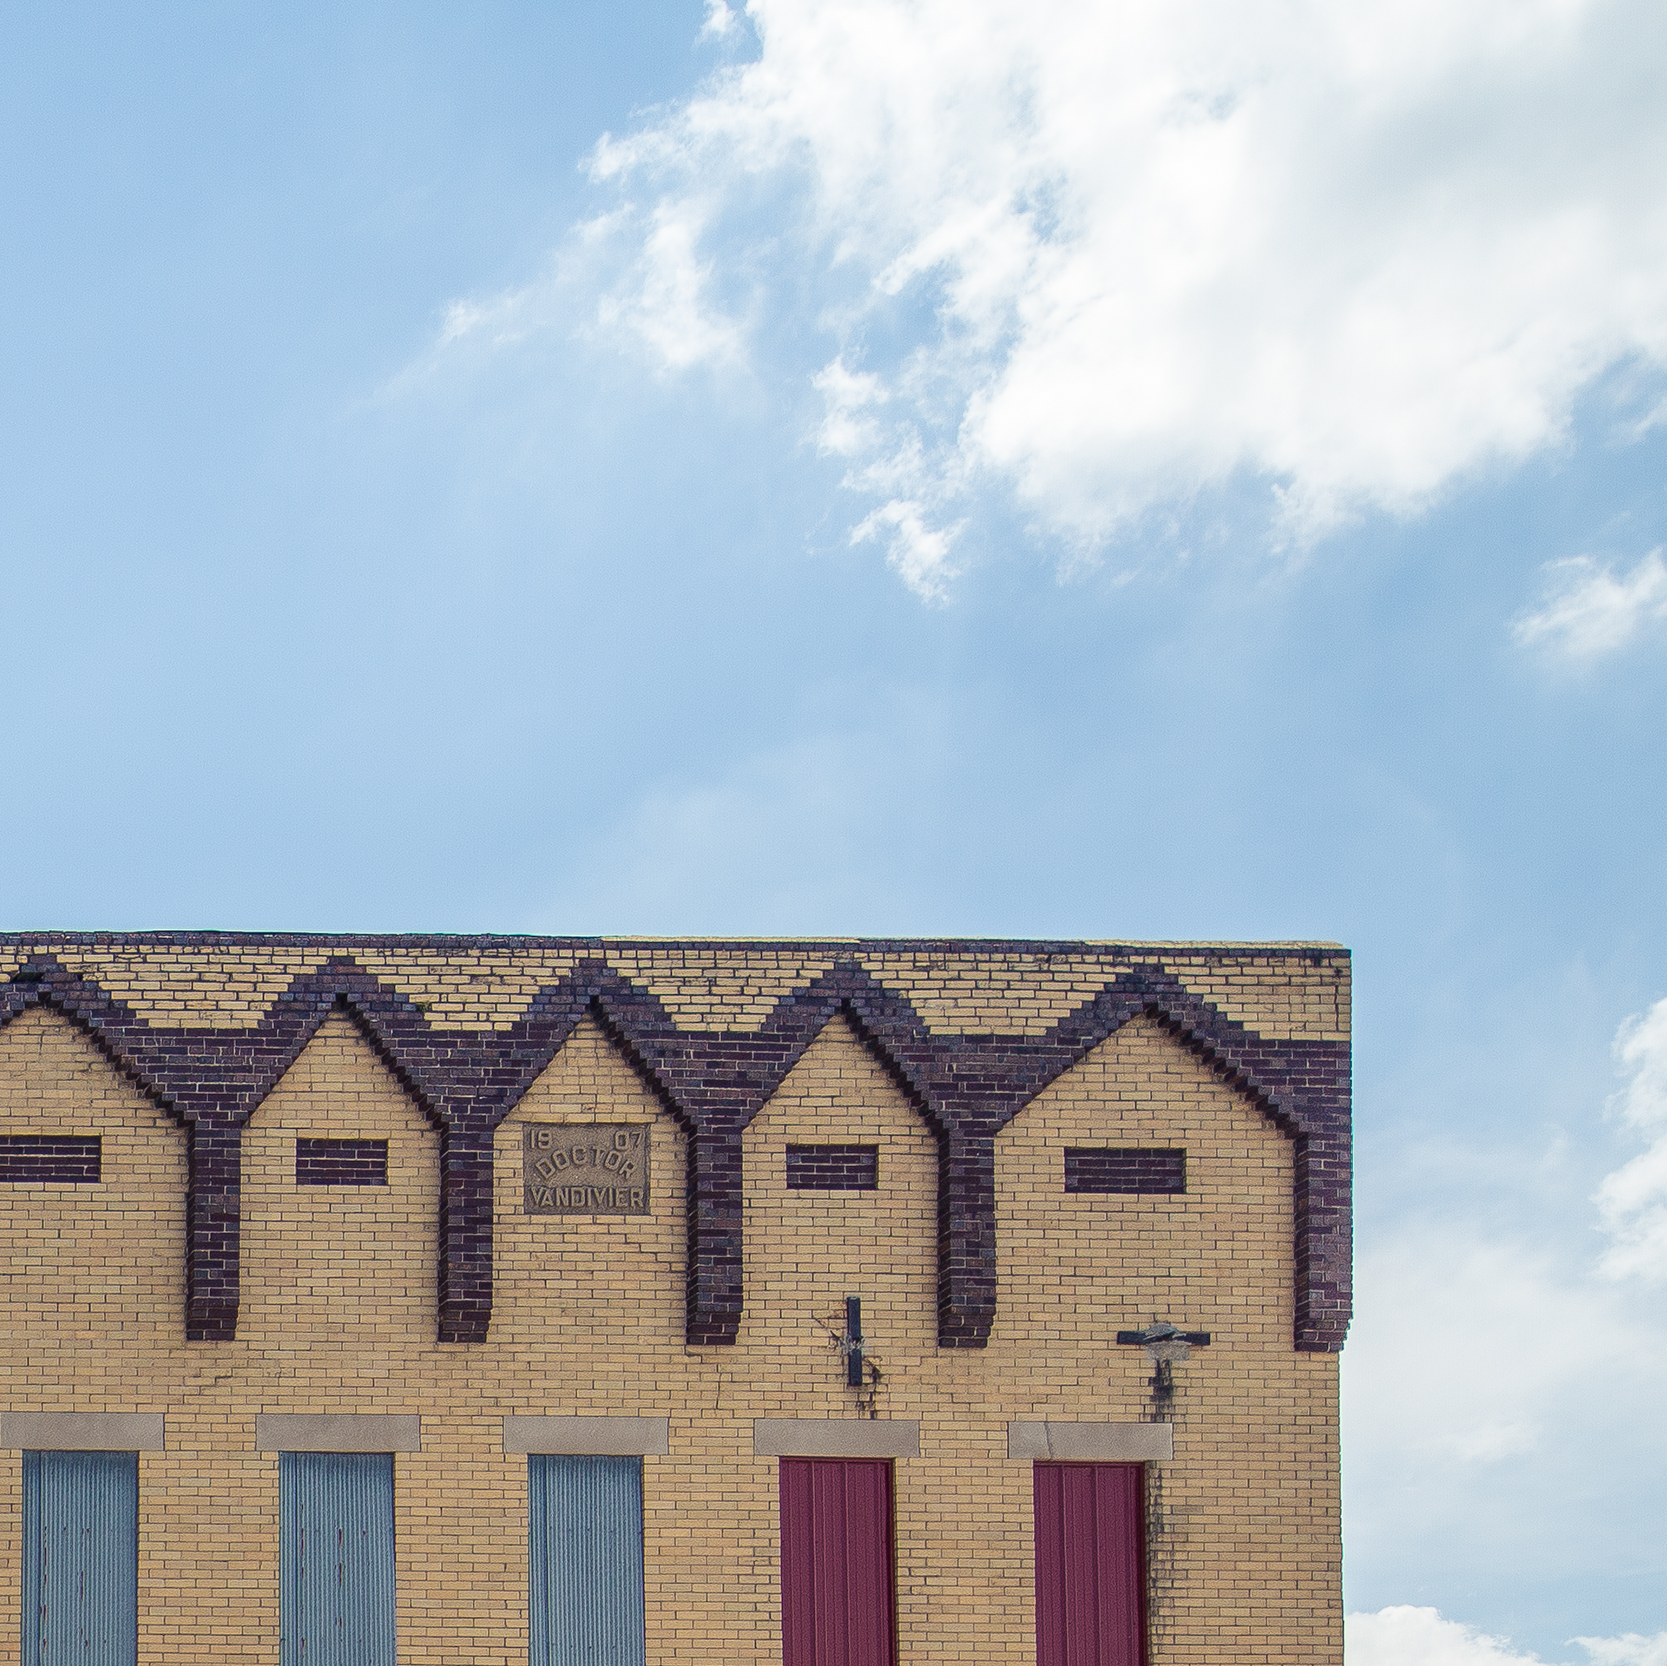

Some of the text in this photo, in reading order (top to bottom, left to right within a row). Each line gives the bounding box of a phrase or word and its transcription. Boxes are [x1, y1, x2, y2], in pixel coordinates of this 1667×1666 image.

[530, 1130, 644, 1151] 19 07
[535, 1145, 638, 1179] DOCTOR
[530, 1186, 645, 1207] VANDIVIER
